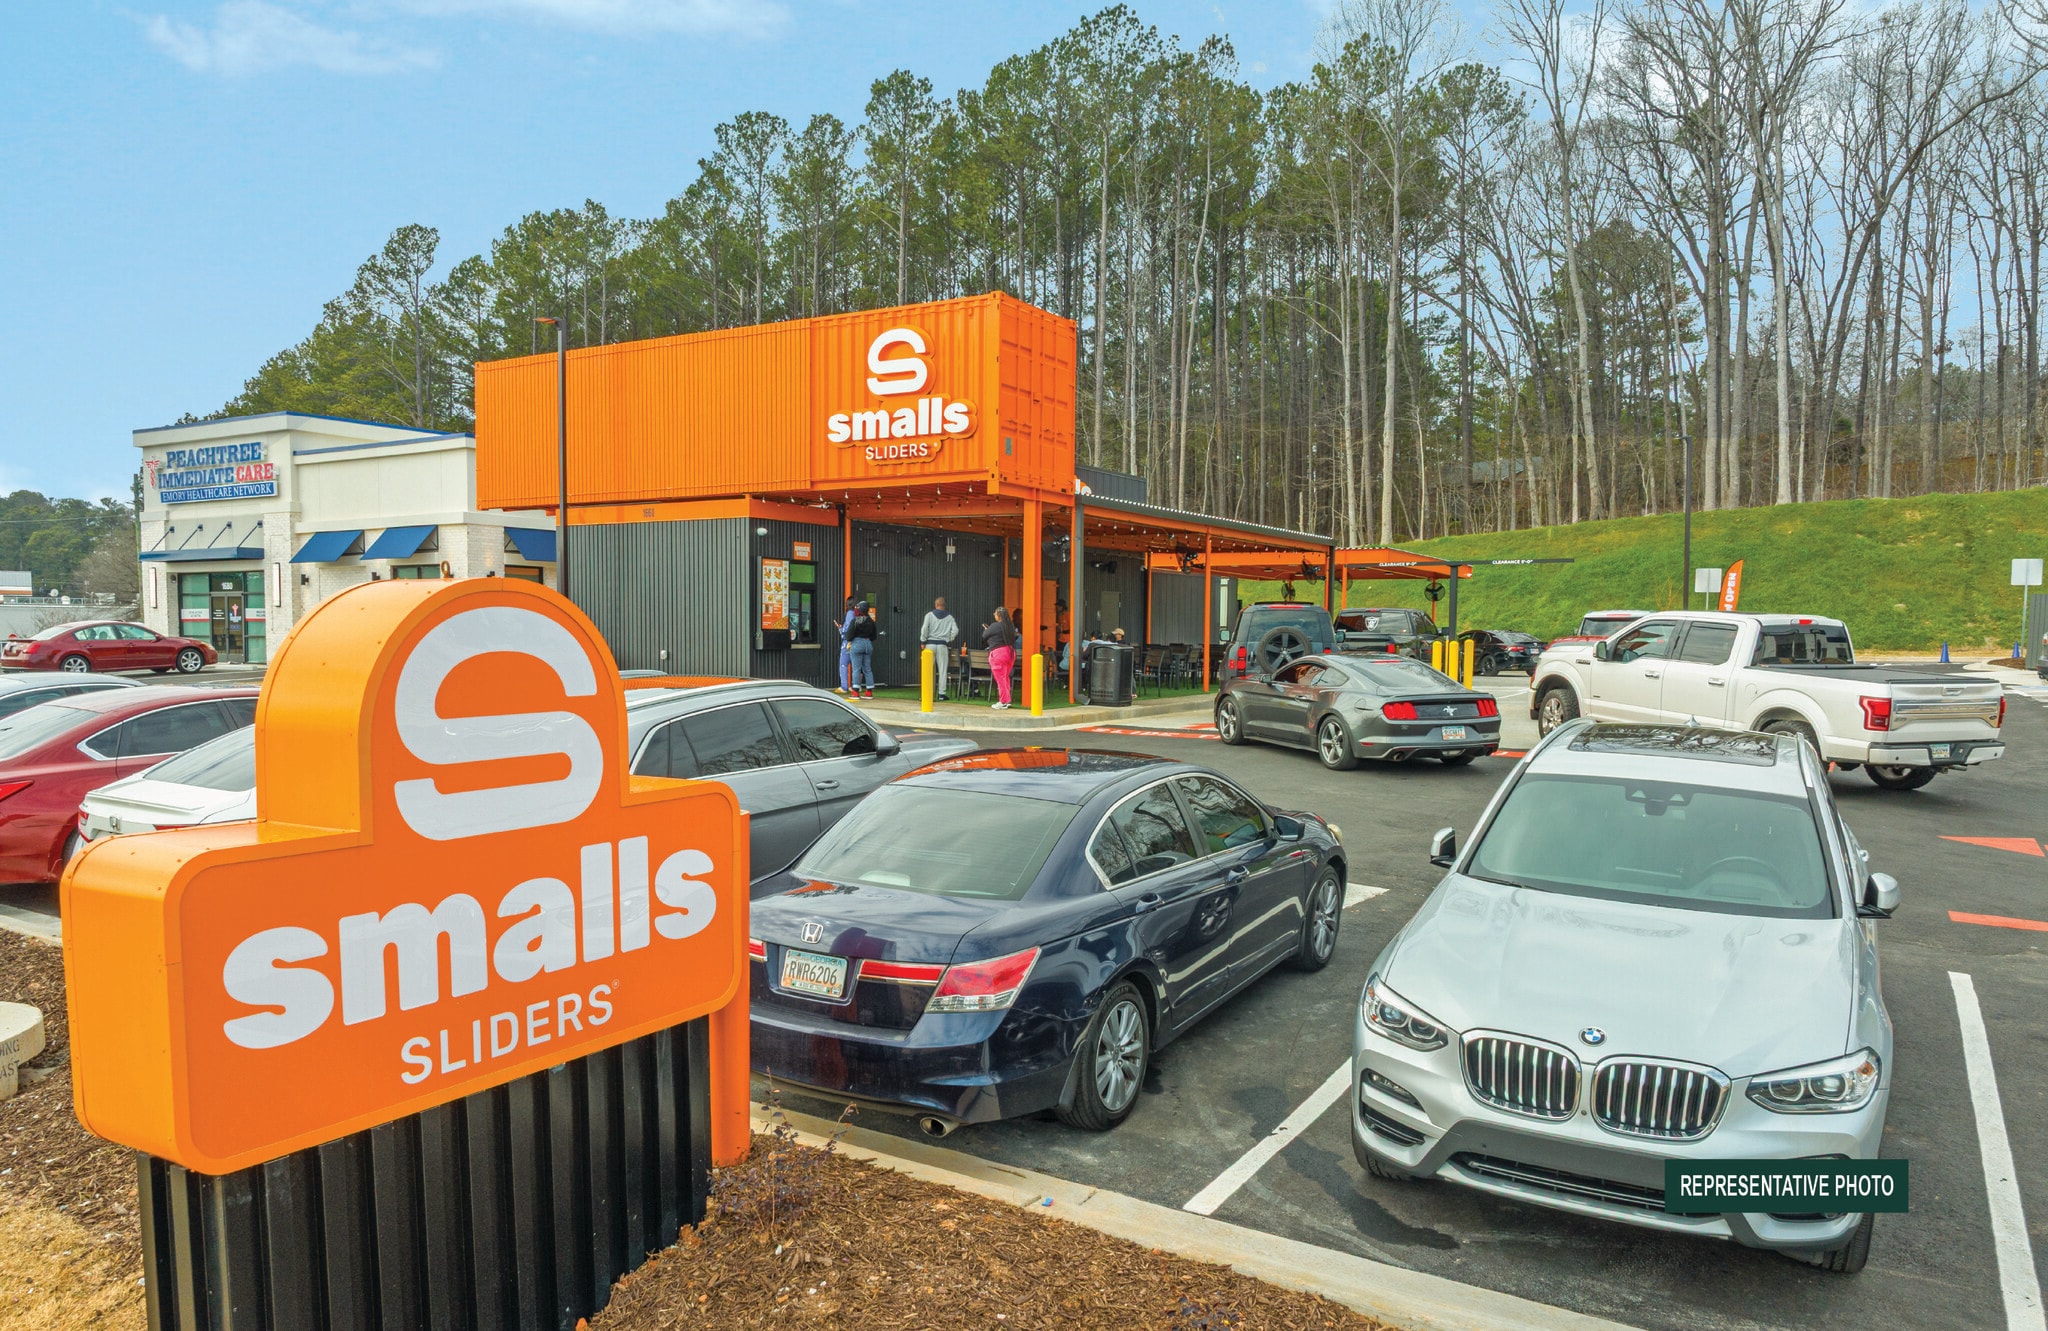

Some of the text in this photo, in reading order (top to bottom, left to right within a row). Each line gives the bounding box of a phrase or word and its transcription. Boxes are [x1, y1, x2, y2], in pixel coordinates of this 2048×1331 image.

[866, 328, 928, 395] S
[827, 397, 970, 443] smalls
[166, 442, 262, 469] PEACHTREE
[866, 443, 928, 460] SLIDERS
[158, 463, 274, 489] IMMEDIATE CARE
[163, 483, 272, 502] EMORY HEALTHCARE NETWORK
[1725, 572, 1737, 603] OPEN
[394, 606, 604, 841] S
[222, 835, 717, 1049] smalls
[788, 961, 838, 986] RWR6206
[810, 955, 843, 967] GEORGIA
[0, 1039, 20, 1057] ING
[401, 984, 614, 1085] SLIDERS
